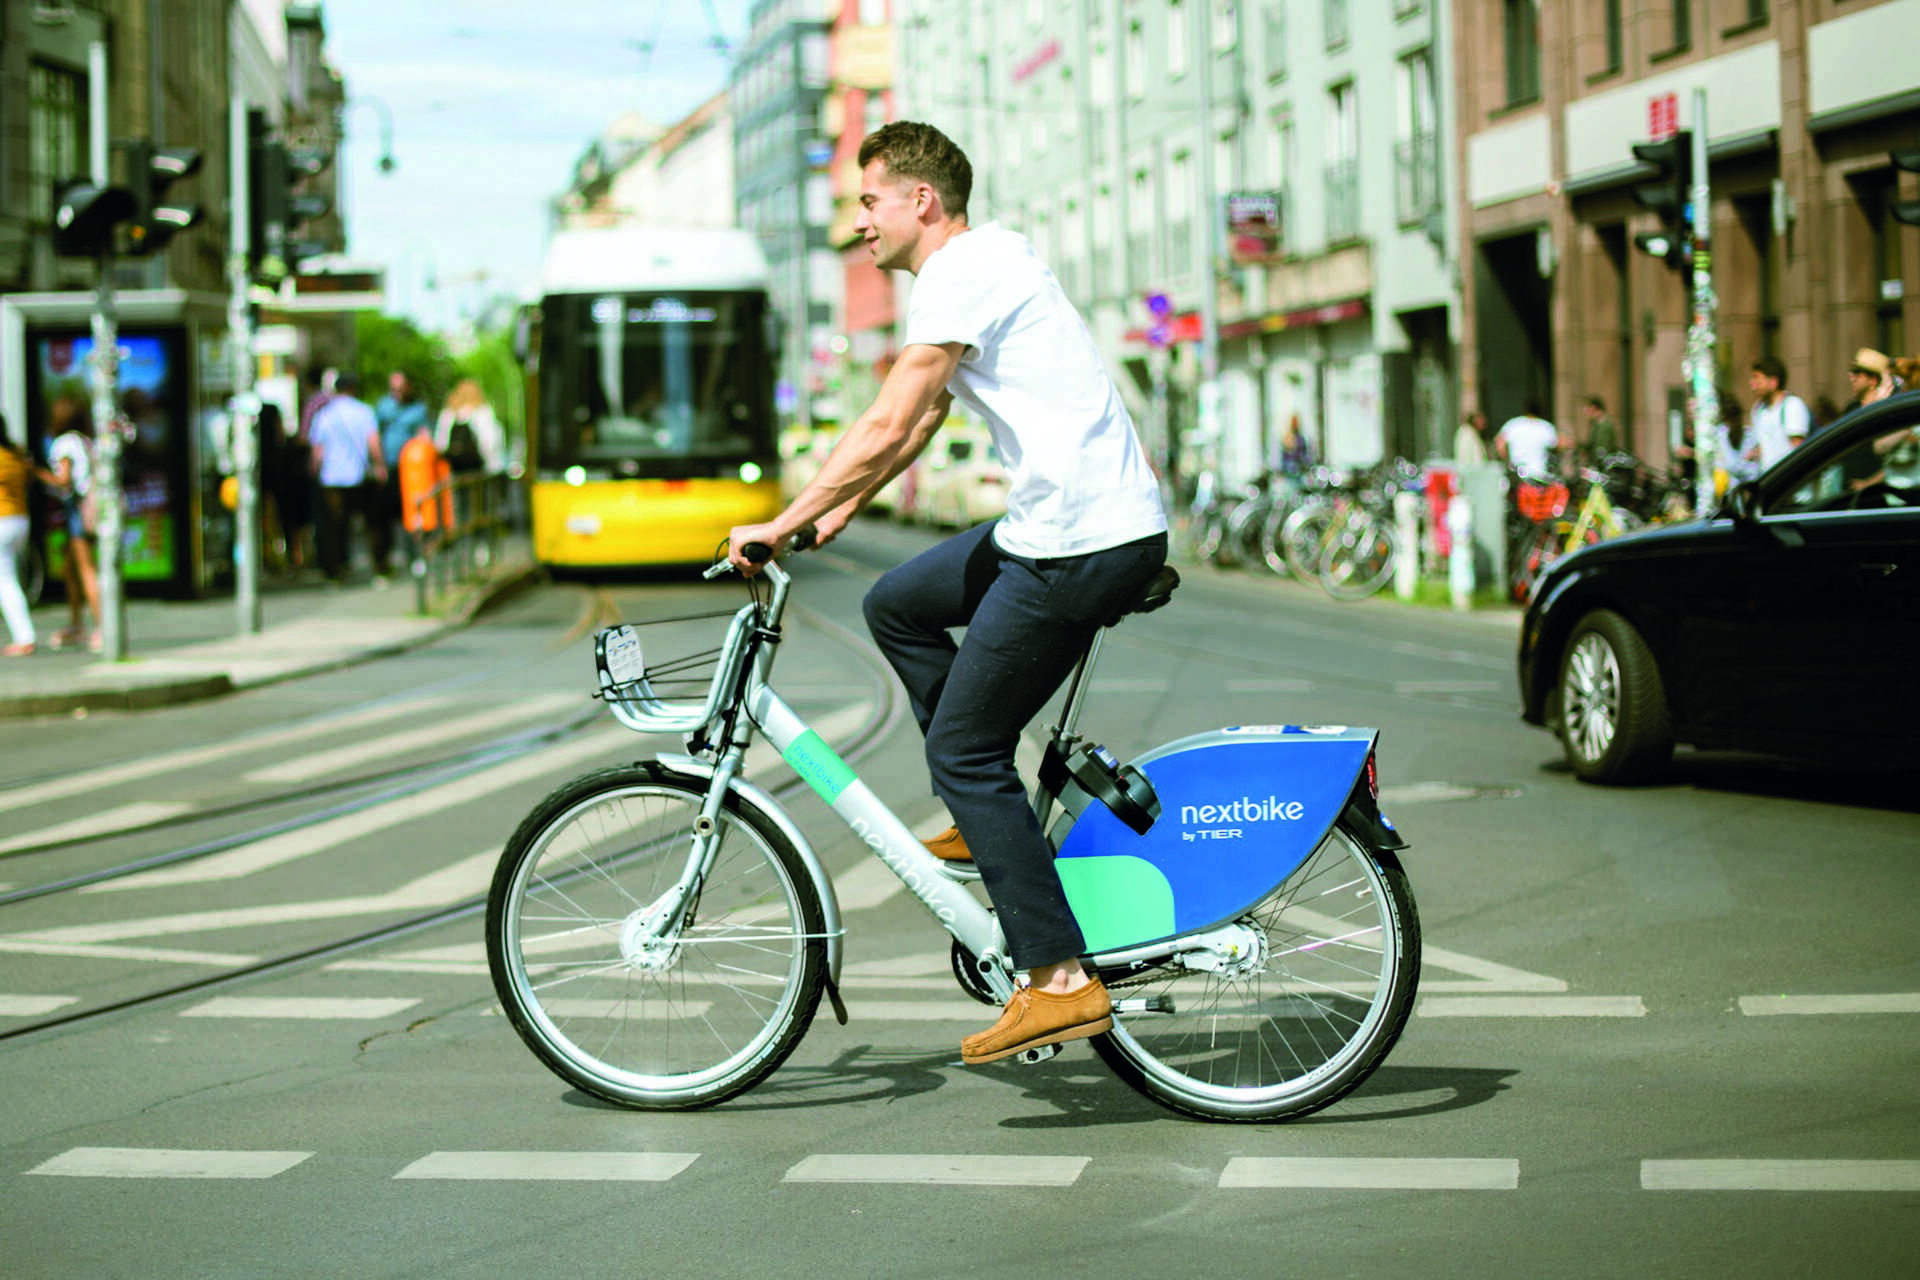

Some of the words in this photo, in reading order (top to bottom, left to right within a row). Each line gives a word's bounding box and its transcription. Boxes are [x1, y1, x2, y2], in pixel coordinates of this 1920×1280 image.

[1181, 795, 1304, 824] nextbike
[1182, 831, 1196, 842] by
[1196, 828, 1243, 840] TIER
[849, 816, 956, 923] nextbike
